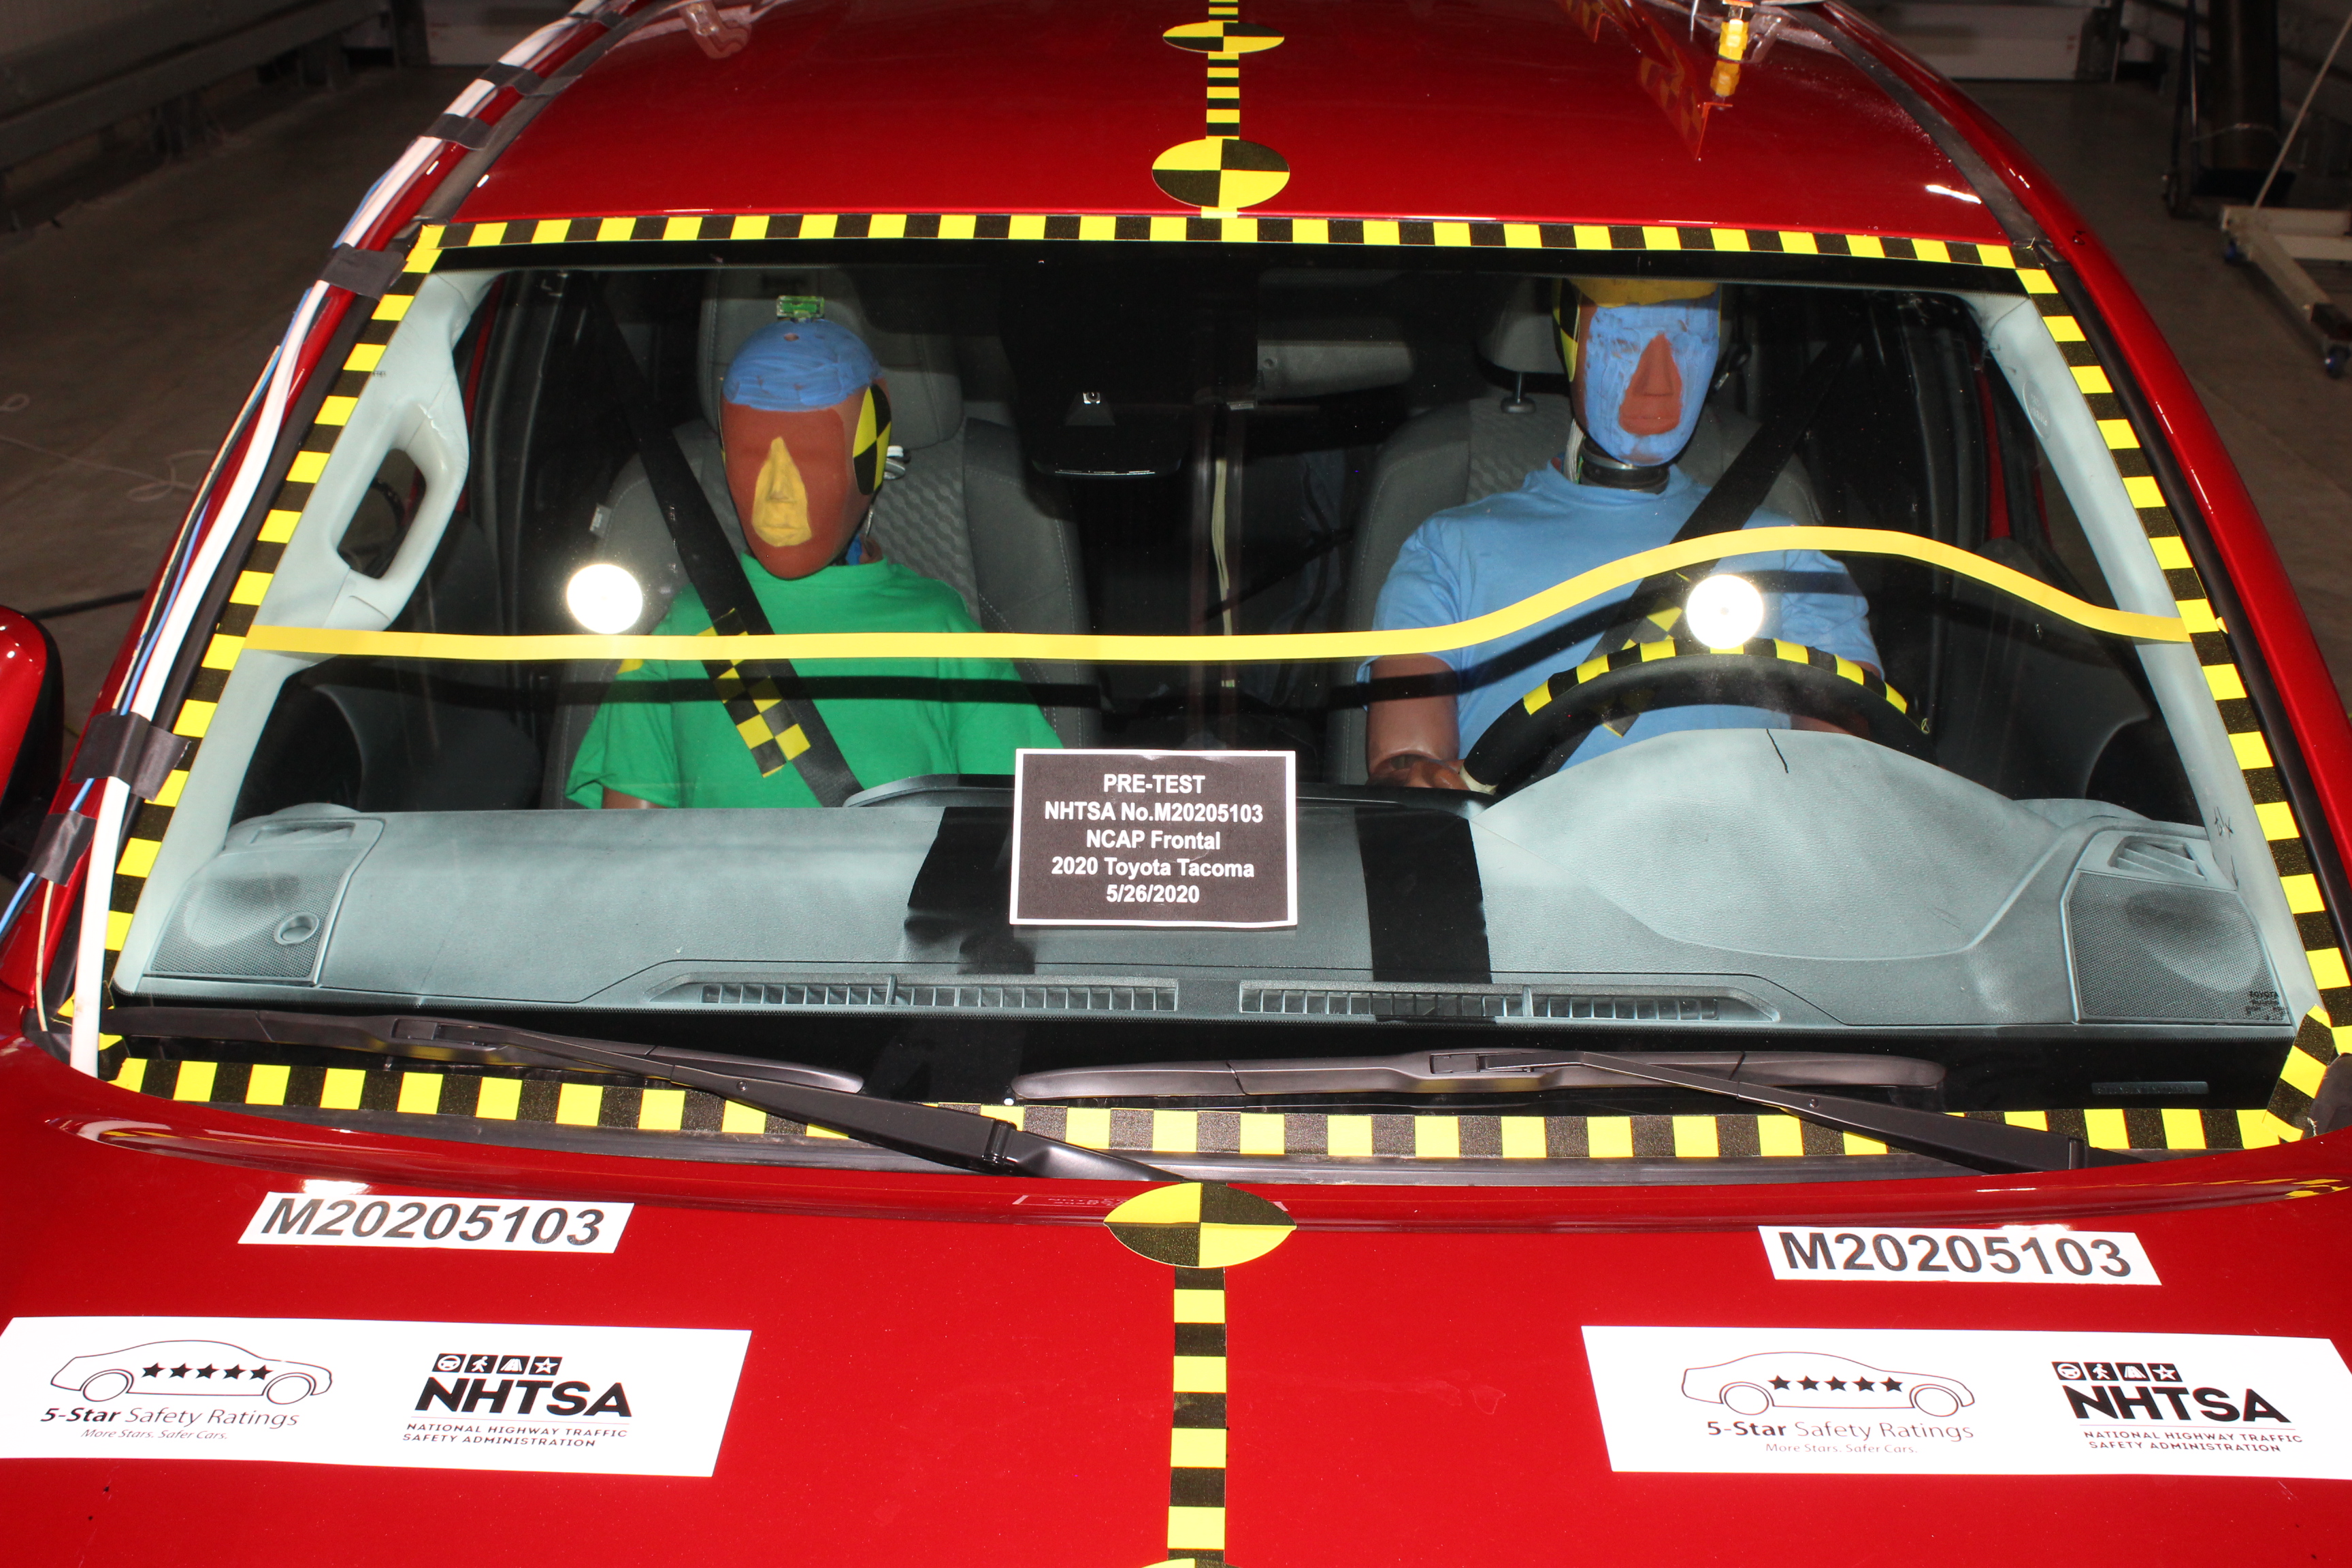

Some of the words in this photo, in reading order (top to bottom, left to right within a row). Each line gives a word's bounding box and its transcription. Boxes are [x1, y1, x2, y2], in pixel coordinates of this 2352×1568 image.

[1103, 773, 1206, 794] PRE-TEST
[1044, 800, 1117, 821] NHTSA
[1120, 802, 1264, 823] No.M20205103
[1086, 829, 1145, 849] NCAP
[1150, 830, 1221, 851] Frontal
[1051, 855, 1098, 875] 2020
[1103, 856, 1171, 881] Toyota
[1176, 858, 1255, 878] Tacoma
[1105, 883, 1200, 904] 5/26/2020
[261, 1198, 605, 1245] M20205103
[1778, 1232, 2132, 1277] M20205103
[414, 1377, 632, 1418] NHTSA
[2062, 1385, 2292, 1423] NHTSA
[39, 1407, 122, 1423] 5-Star
[124, 1407, 203, 1428] Safety
[207, 1409, 300, 1430] Ratings
[80, 1428, 116, 1439] More
[118, 1429, 154, 1439] Stars.
[157, 1429, 194, 1439] Safer
[196, 1430, 228, 1440] Cars.
[402, 1433, 458, 1443] SAFETY
[462, 1435, 596, 1447] ADMINISTRATION
[406, 1423, 482, 1433] NATIONAL
[487, 1426, 560, 1435] HIGHWAY
[565, 1428, 628, 1437] TRAFFIC
[1706, 1420, 1787, 1437] 5-Star
[1794, 1421, 1872, 1441] Safety
[1878, 1422, 1974, 1443] Ratings
[2083, 1431, 2161, 1439] NATIONAL
[2164, 1432, 2236, 1441] HIGHWAY
[2239, 1433, 2303, 1443] TRAFFIC
[1765, 1443, 1801, 1452] More
[1804, 1443, 1842, 1453] Stars.
[1846, 1443, 1880, 1453] Safer
[1884, 1444, 1918, 1454] Cars.
[2089, 1441, 2143, 1450] SAFETY
[2149, 1441, 2282, 1452] ADMINISTRATION
